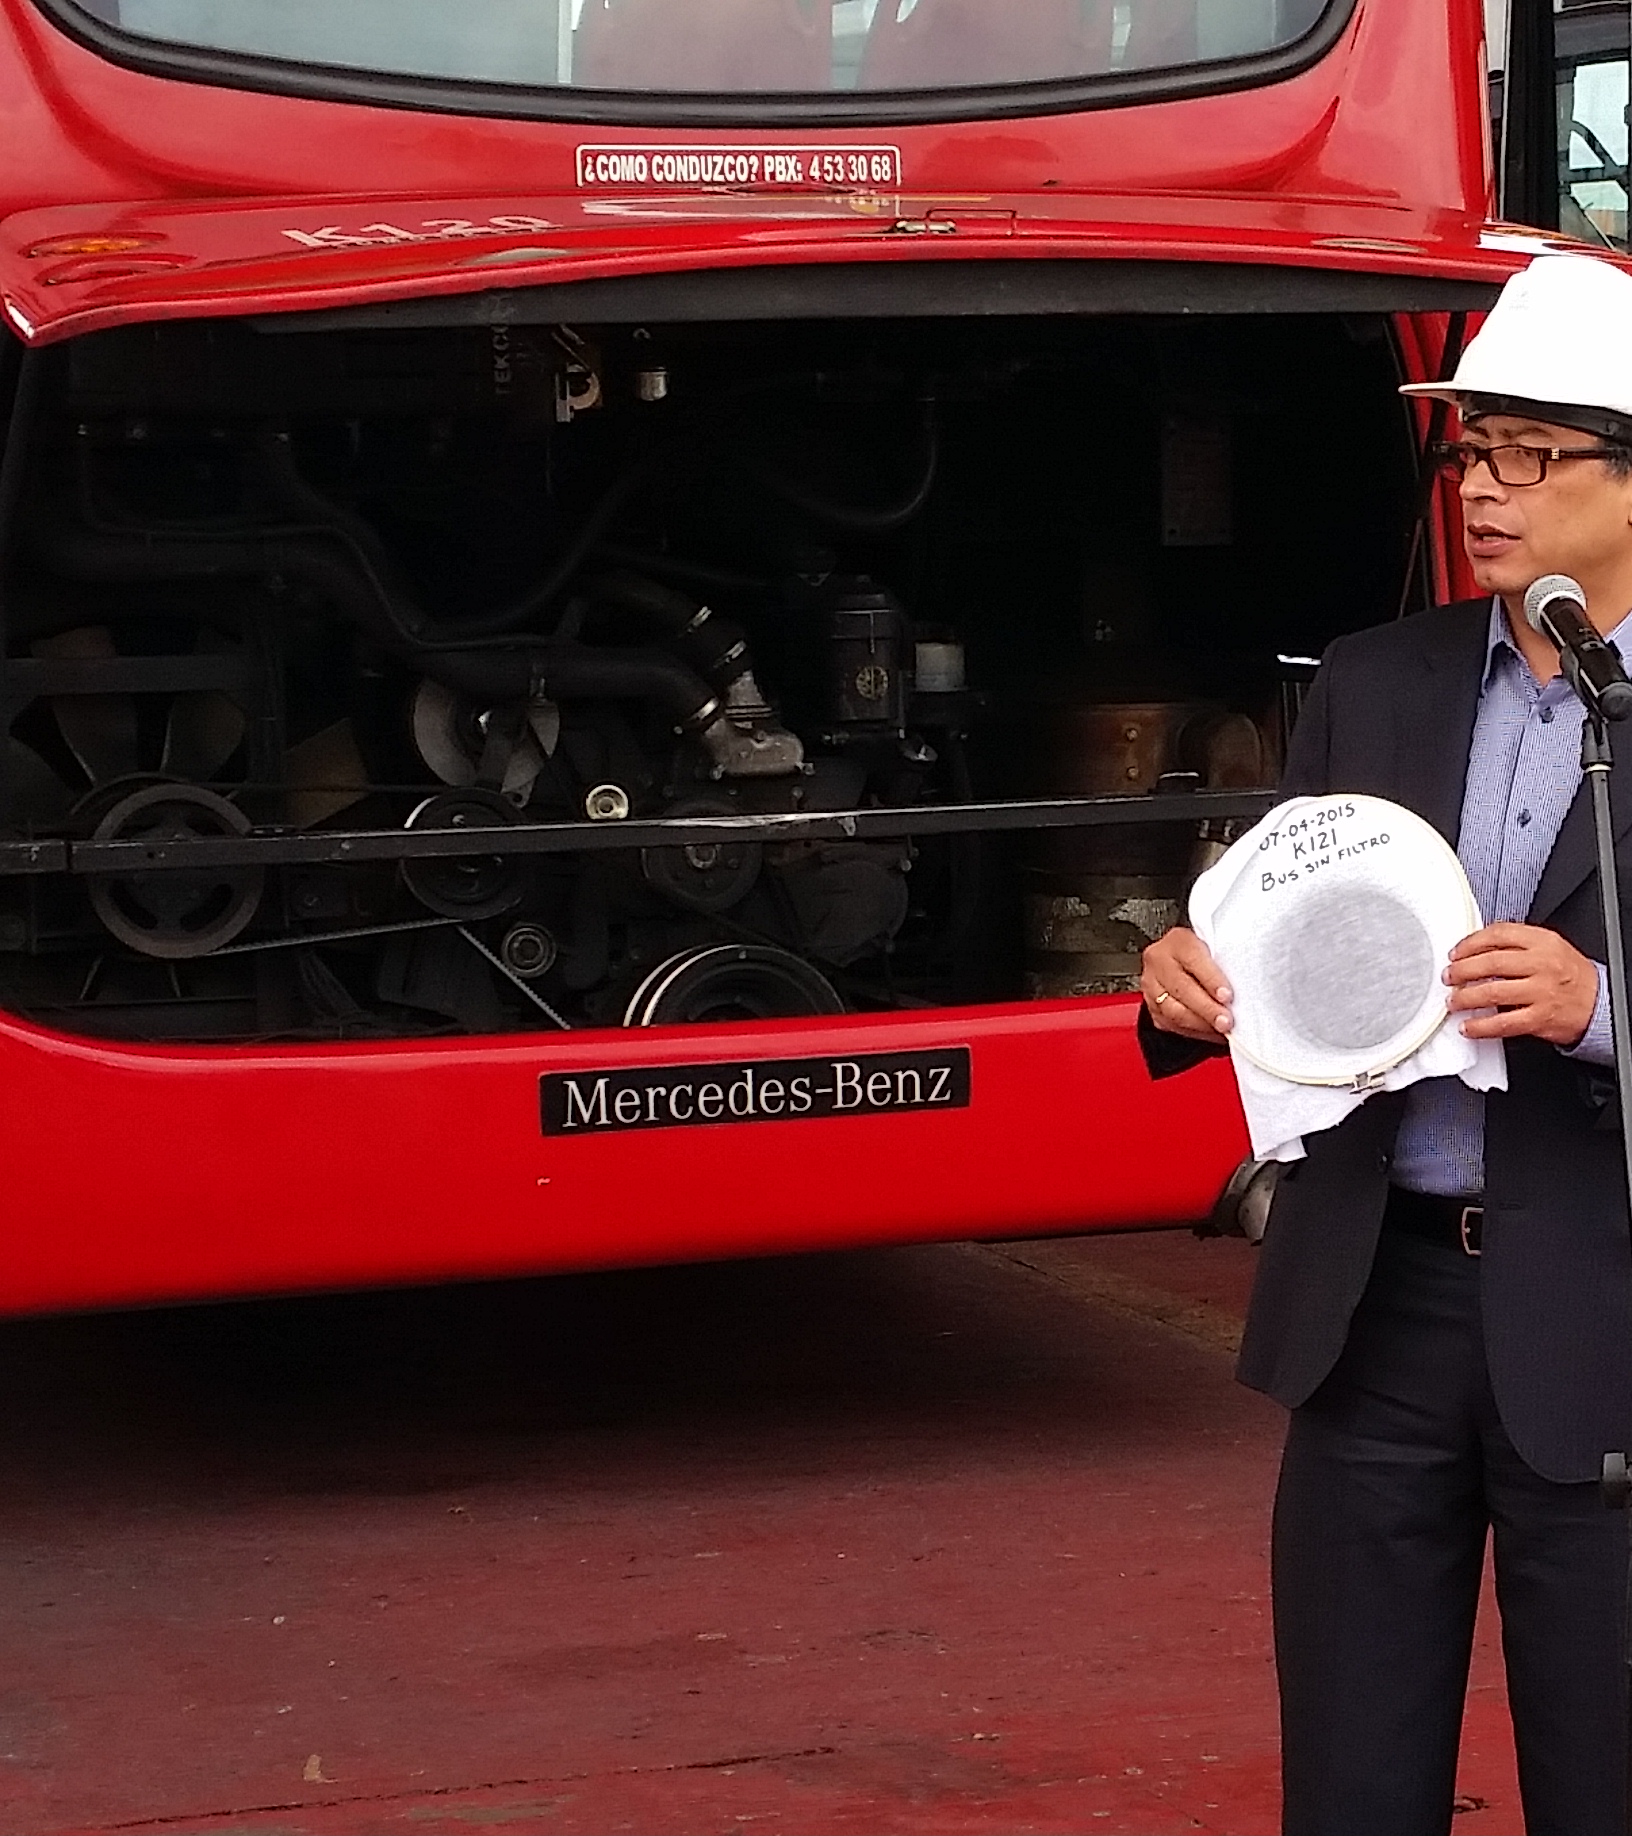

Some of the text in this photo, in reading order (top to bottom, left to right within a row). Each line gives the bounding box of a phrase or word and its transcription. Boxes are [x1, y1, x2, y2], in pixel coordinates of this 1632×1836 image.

[585, 154, 648, 183] ¿COMO
[651, 154, 759, 183] CONDUZCO?
[763, 154, 804, 183] PBX:
[808, 154, 821, 182] 4
[1259, 802, 1356, 851] 07-04-2015
[1292, 828, 1338, 860] K121
[1337, 832, 1391, 861] FILTRO
[562, 1062, 953, 1128] Mercedes-Benz
